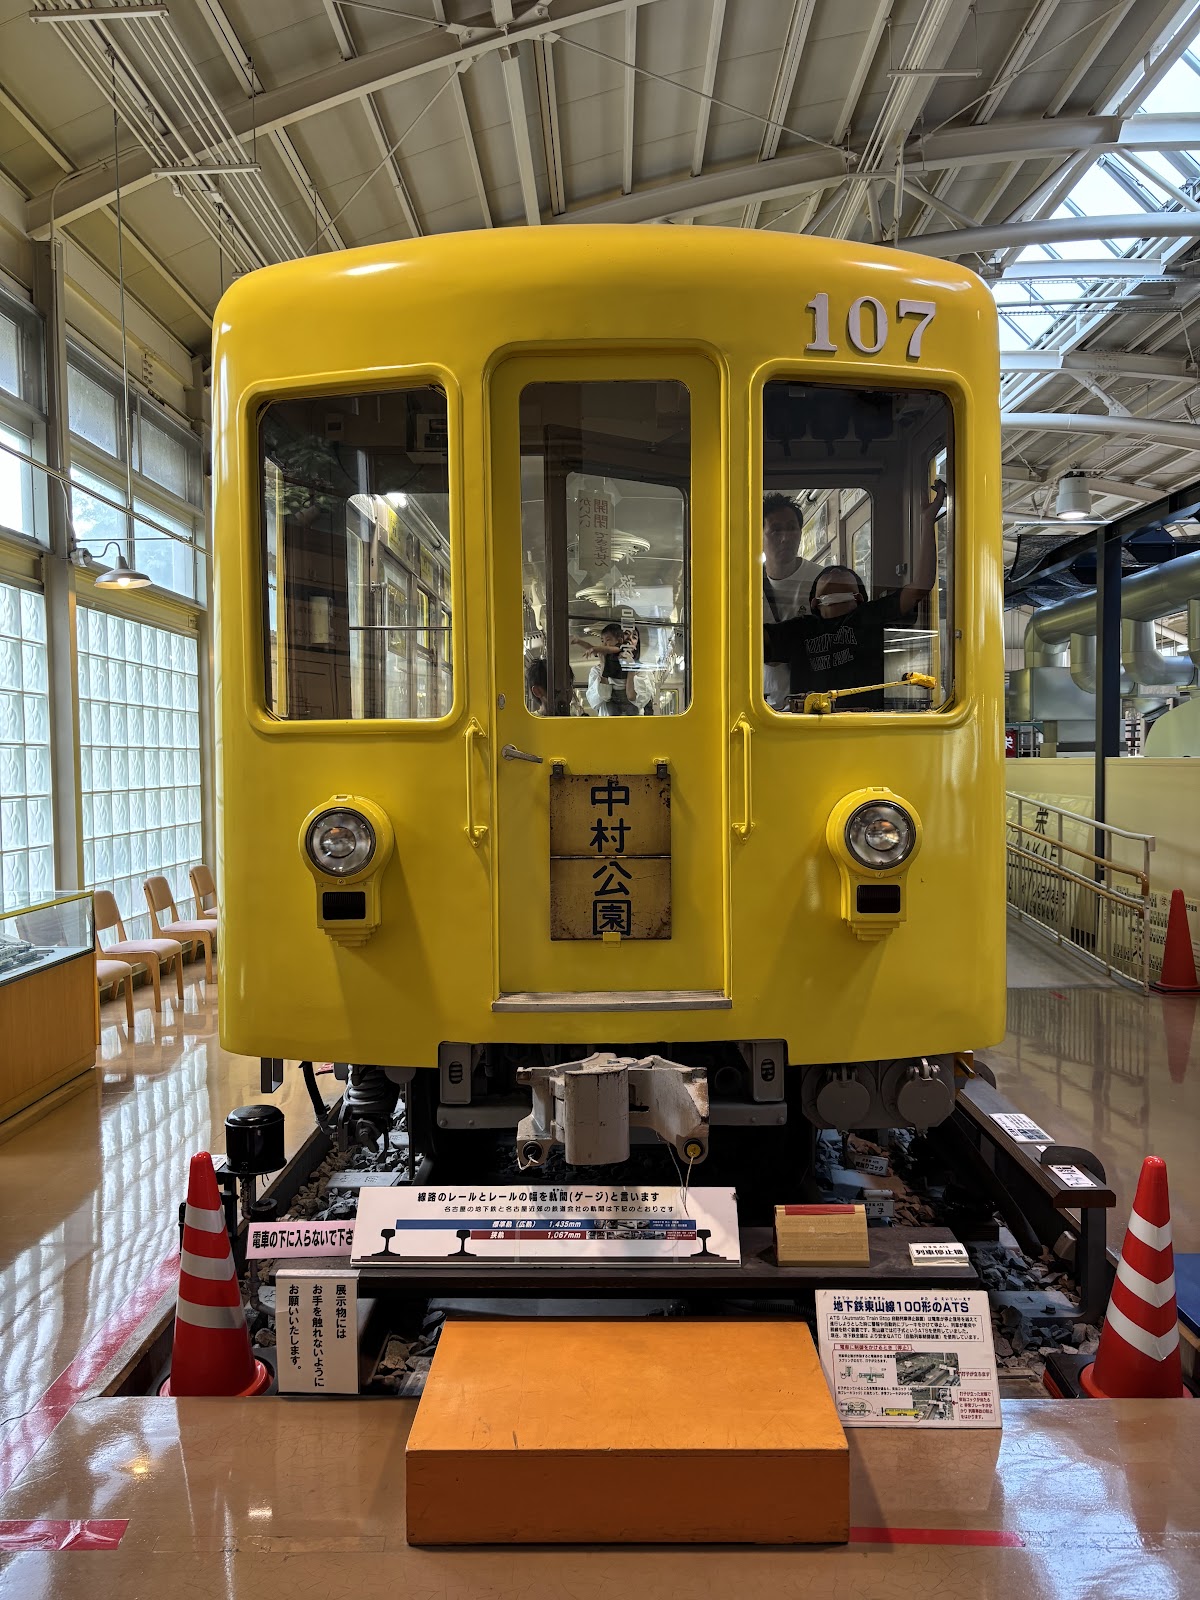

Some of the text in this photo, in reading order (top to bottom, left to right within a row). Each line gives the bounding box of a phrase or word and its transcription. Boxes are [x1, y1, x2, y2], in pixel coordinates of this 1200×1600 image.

[806, 292, 936, 357] 107
[590, 779, 632, 936] 中村公園
[547, 1230, 581, 1239] 1,067mm
[549, 1220, 582, 1228] 1,435mm
[288, 1284, 302, 1370] お願いいたします。
[312, 1284, 324, 1387] お手を触れないように
[336, 1284, 347, 1339] 展示物には
[833, 1300, 969, 1313] 地下鉄東山線100形のATS
